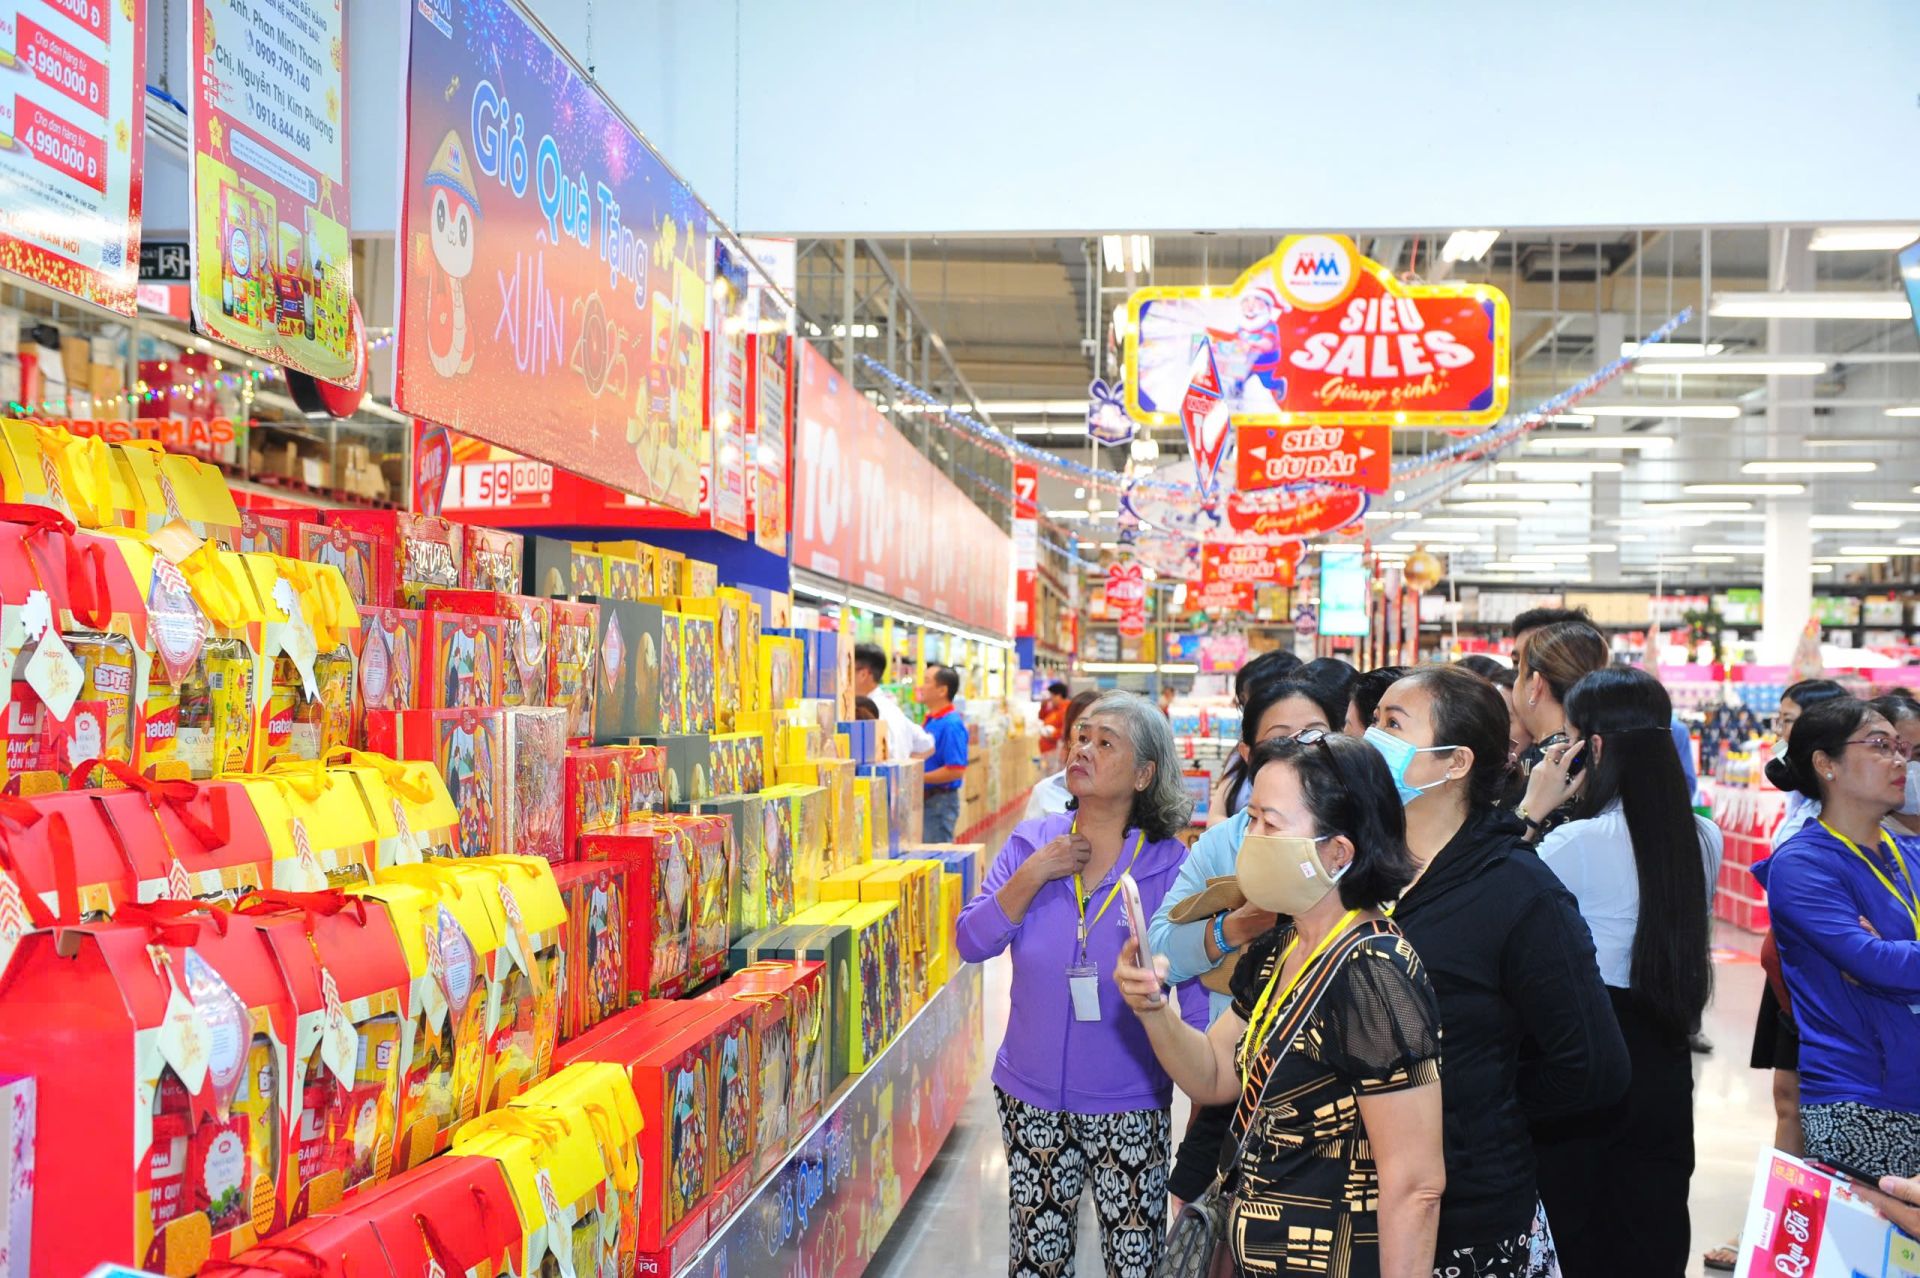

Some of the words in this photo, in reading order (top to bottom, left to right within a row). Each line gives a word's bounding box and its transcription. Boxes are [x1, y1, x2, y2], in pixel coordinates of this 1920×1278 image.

[253, 9, 275, 40] Phan
[277, 27, 297, 57] Minh
[299, 44, 323, 77] Thanh
[255, 39, 311, 93] 0909.799.140
[27, 44, 86, 96] 3.990.000
[216, 44, 235, 76] Chị.
[273, 83, 286, 112] Thị
[287, 94, 303, 119] Kim
[304, 105, 334, 144] Phượng
[25, 126, 85, 172] 4.990.000
[255, 102, 311, 152] 0918.844.668
[471, 79, 528, 199] Giỏ
[536, 134, 592, 249] Quà
[597, 180, 649, 311] Tặng
[494, 229, 565, 378] XUÂN
[1338, 291, 1426, 334] SIÊU
[1289, 330, 1476, 378] SALES
[1281, 424, 1344, 452] SIÊU
[1236, 1050, 1277, 1131] LOVE
[1783, 1207, 1810, 1243] Tết
[1775, 1243, 1811, 1278] Quà
